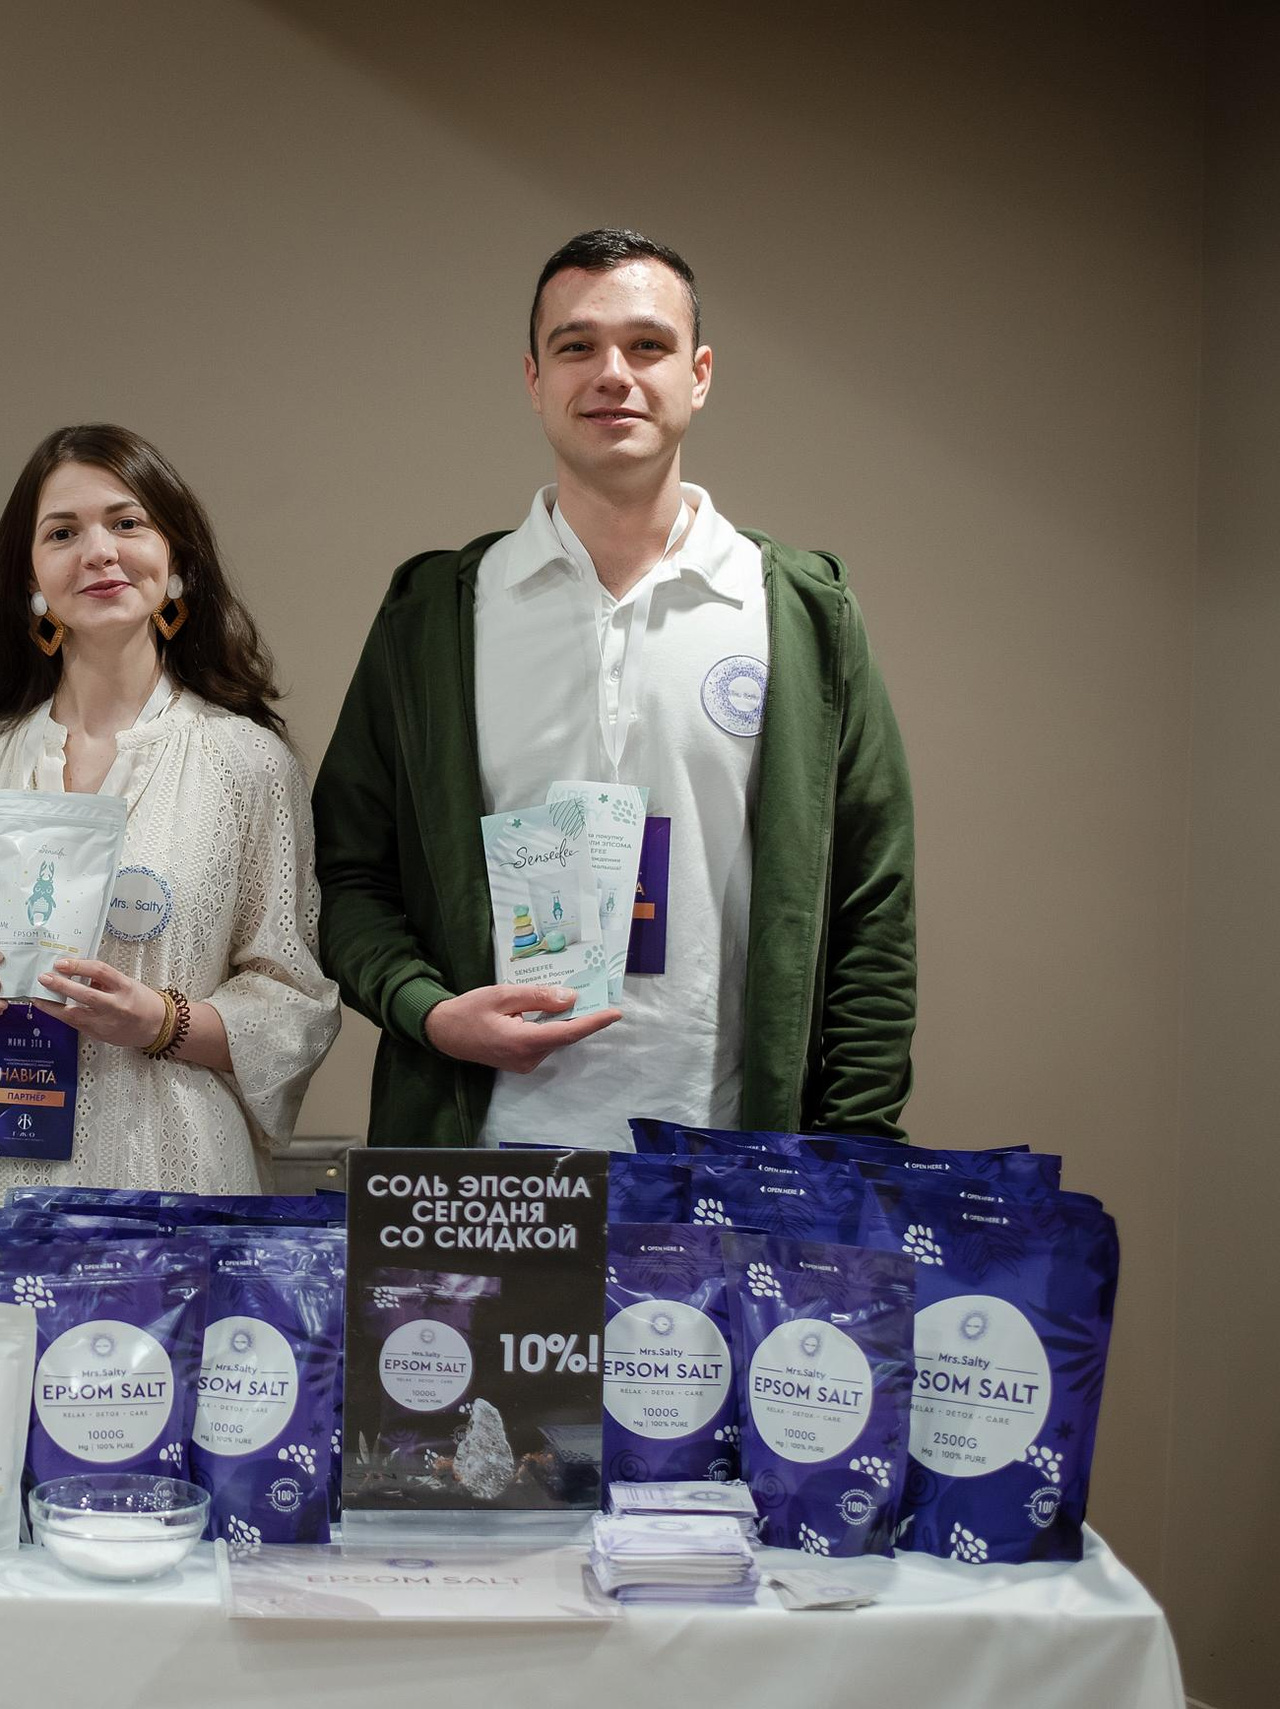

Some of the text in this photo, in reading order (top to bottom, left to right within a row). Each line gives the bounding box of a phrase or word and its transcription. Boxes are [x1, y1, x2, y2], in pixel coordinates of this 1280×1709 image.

[135, 899, 164, 914] Salty
[514, 963, 554, 976] SENSEEFEE
[516, 975, 542, 985] Первая
[549, 969, 575, 978] России
[367, 1174, 592, 1198] СОЛЬ ЭПСОМА
[412, 1200, 545, 1226] СЕГОДНЯ
[380, 1223, 577, 1252] СО СКИДКОЙ
[499, 1333, 599, 1373] 10%!
[639, 1348, 683, 1358] Mrs.Salty
[384, 1359, 466, 1373] EPSOM SALT
[938, 1353, 991, 1370] Mrs.Salty
[82, 1368, 127, 1378] Mrs.Salty
[603, 1360, 723, 1379] EPSOM SALT
[786, 1367, 826, 1380] Mrs.Salty
[43, 1382, 166, 1400] EPSOM SALT
[198, 1377, 289, 1396] SOM SALT
[754, 1376, 863, 1406] EPSOM SALT
[918, 1369, 1039, 1405] SOM SALT
[642, 1407, 679, 1417] 1000G
[210, 1422, 244, 1433] 1000G
[985, 1415, 1010, 1425] CARE
[88, 1430, 124, 1440] 1000G
[784, 1428, 816, 1441] 1000G
[933, 1431, 978, 1449] 2500G
[941, 1450, 962, 1460] 100%
[964, 1454, 987, 1465] PURE
[308, 1575, 522, 1585] EPSOM SALT
